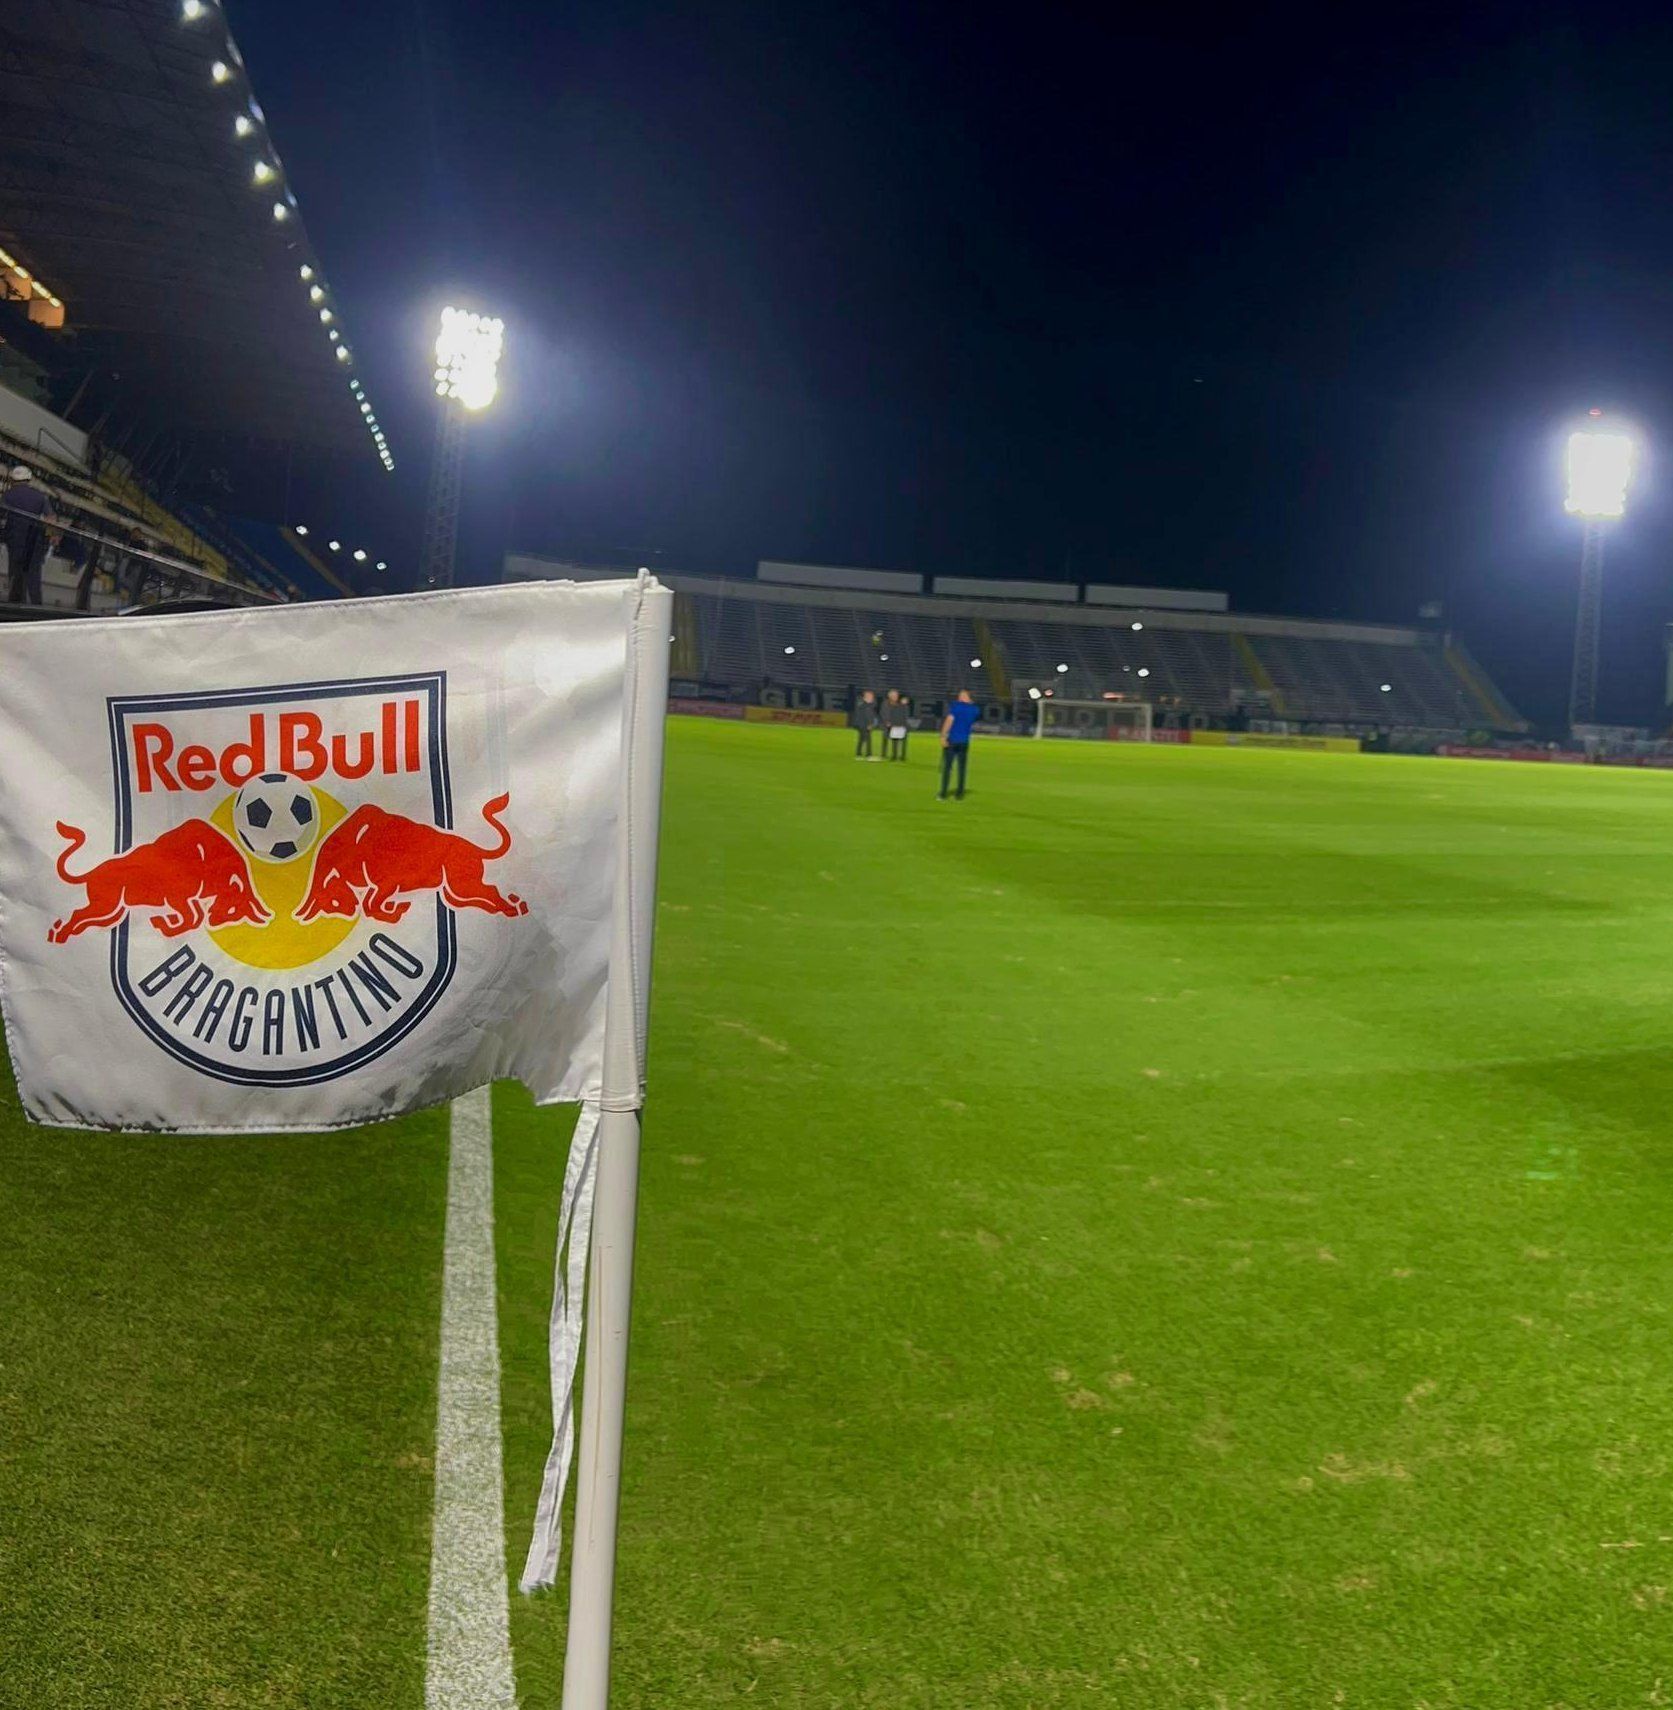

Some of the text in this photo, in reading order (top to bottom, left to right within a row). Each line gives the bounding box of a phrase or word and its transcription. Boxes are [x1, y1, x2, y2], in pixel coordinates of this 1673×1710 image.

[132, 700, 421, 793] Red Bull
[138, 932, 425, 1056] BRAGANTINO
